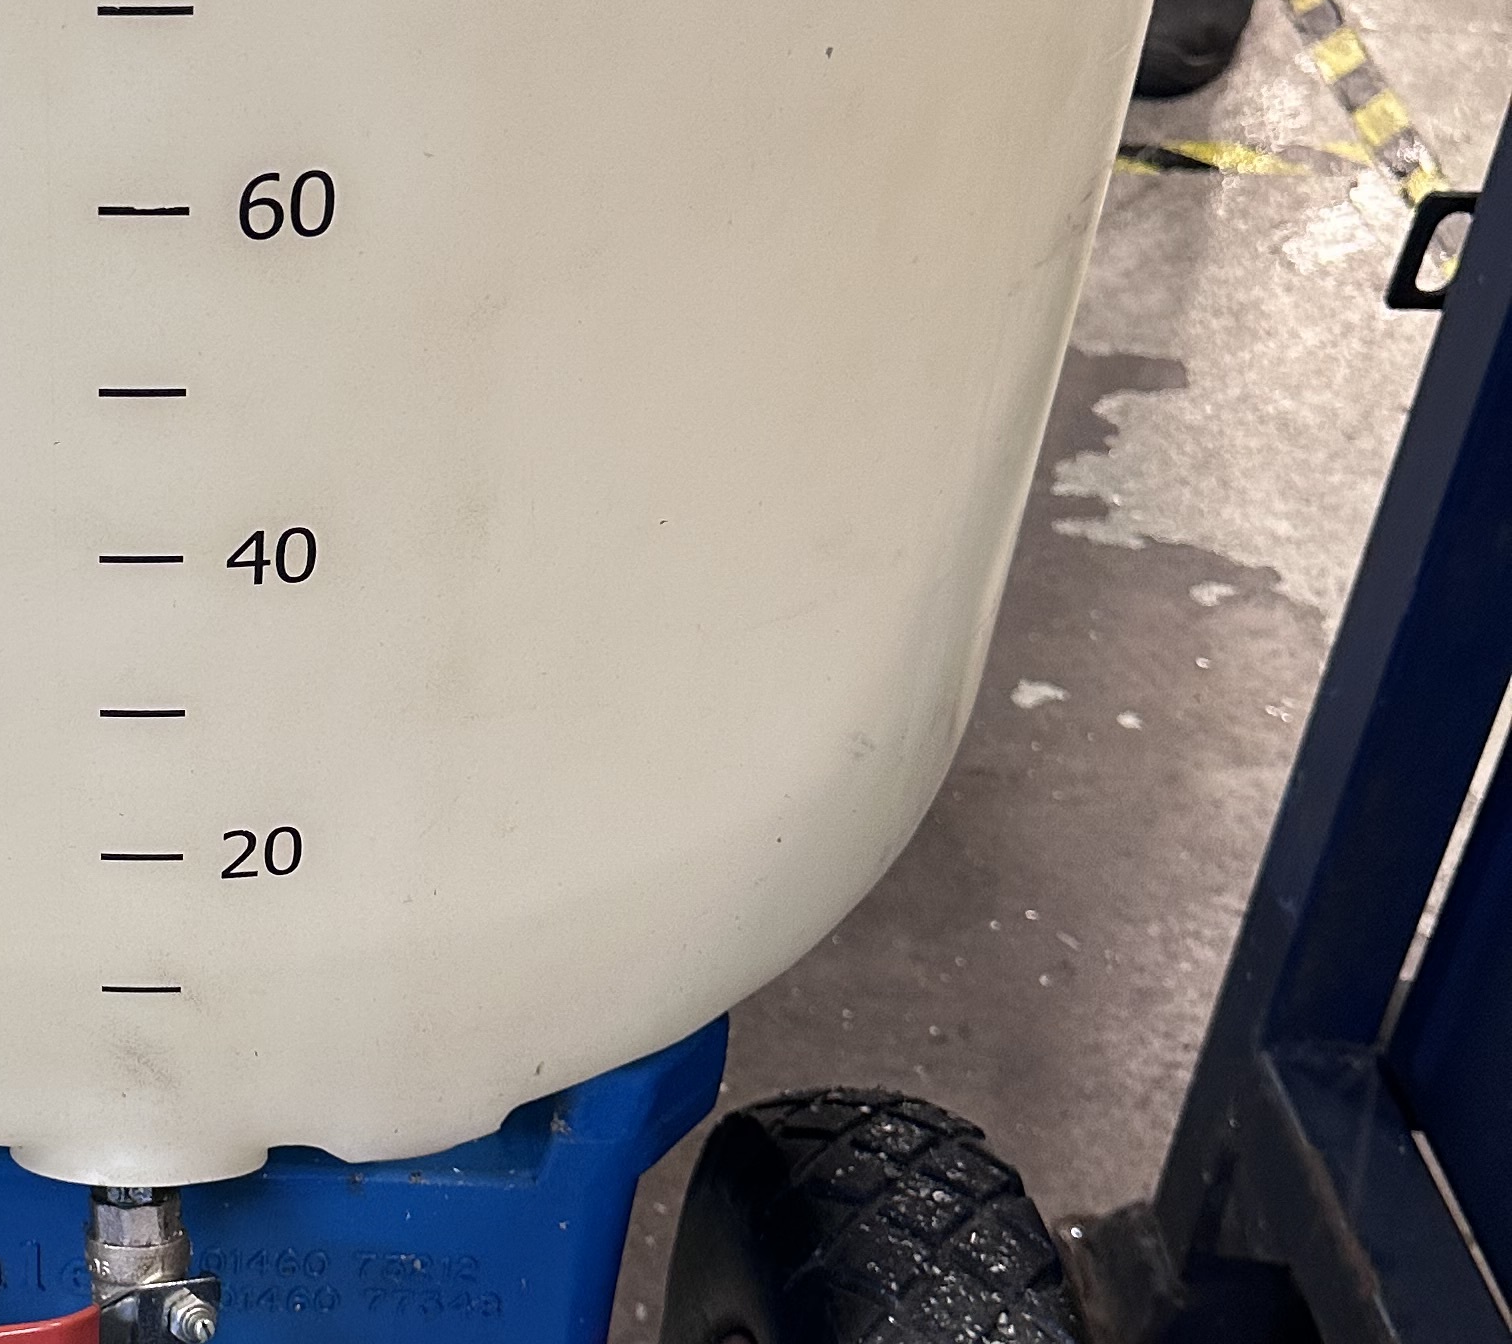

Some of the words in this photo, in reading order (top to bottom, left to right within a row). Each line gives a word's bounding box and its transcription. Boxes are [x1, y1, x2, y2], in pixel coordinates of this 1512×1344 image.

[239, 169, 335, 241] 60
[226, 526, 317, 585] 40
[221, 826, 302, 880] 20
